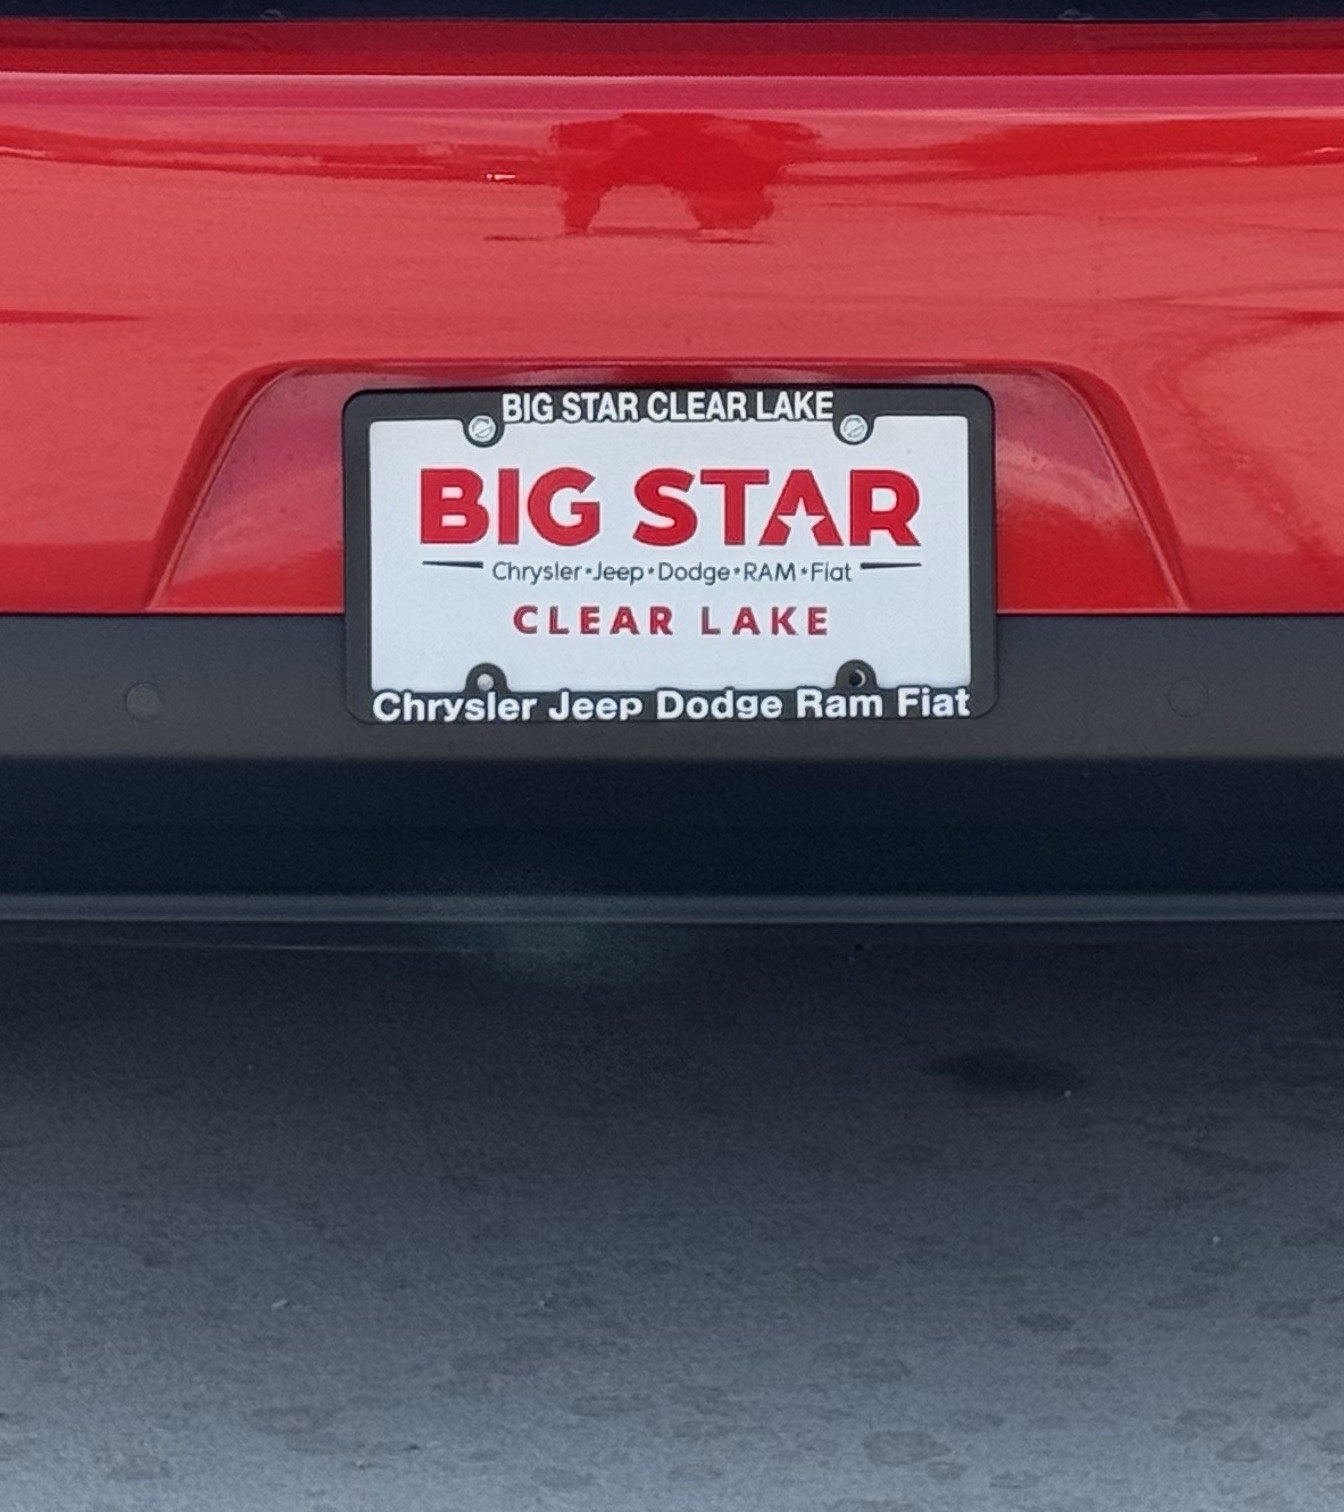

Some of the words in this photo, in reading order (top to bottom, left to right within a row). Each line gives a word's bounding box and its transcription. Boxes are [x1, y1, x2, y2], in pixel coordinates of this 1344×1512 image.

[502, 392, 554, 422] BIG
[562, 391, 639, 421] STAR
[646, 390, 747, 421] CLEAR
[756, 390, 834, 420] LAKE
[418, 466, 601, 547] BIG
[632, 466, 921, 547] STAR
[491, 561, 582, 586] Chrysler
[592, 561, 645, 586] Jeep
[657, 561, 731, 586] Dodge
[743, 561, 797, 582] RAM
[810, 561, 853, 582] Fiat
[513, 605, 673, 635] CLEAR
[701, 605, 829, 636] LAKE
[372, 691, 538, 722] Chrysler
[548, 692, 644, 722] Jeep
[656, 690, 784, 720] Dodge
[796, 688, 884, 719] Ram
[897, 686, 971, 718] Fiat
